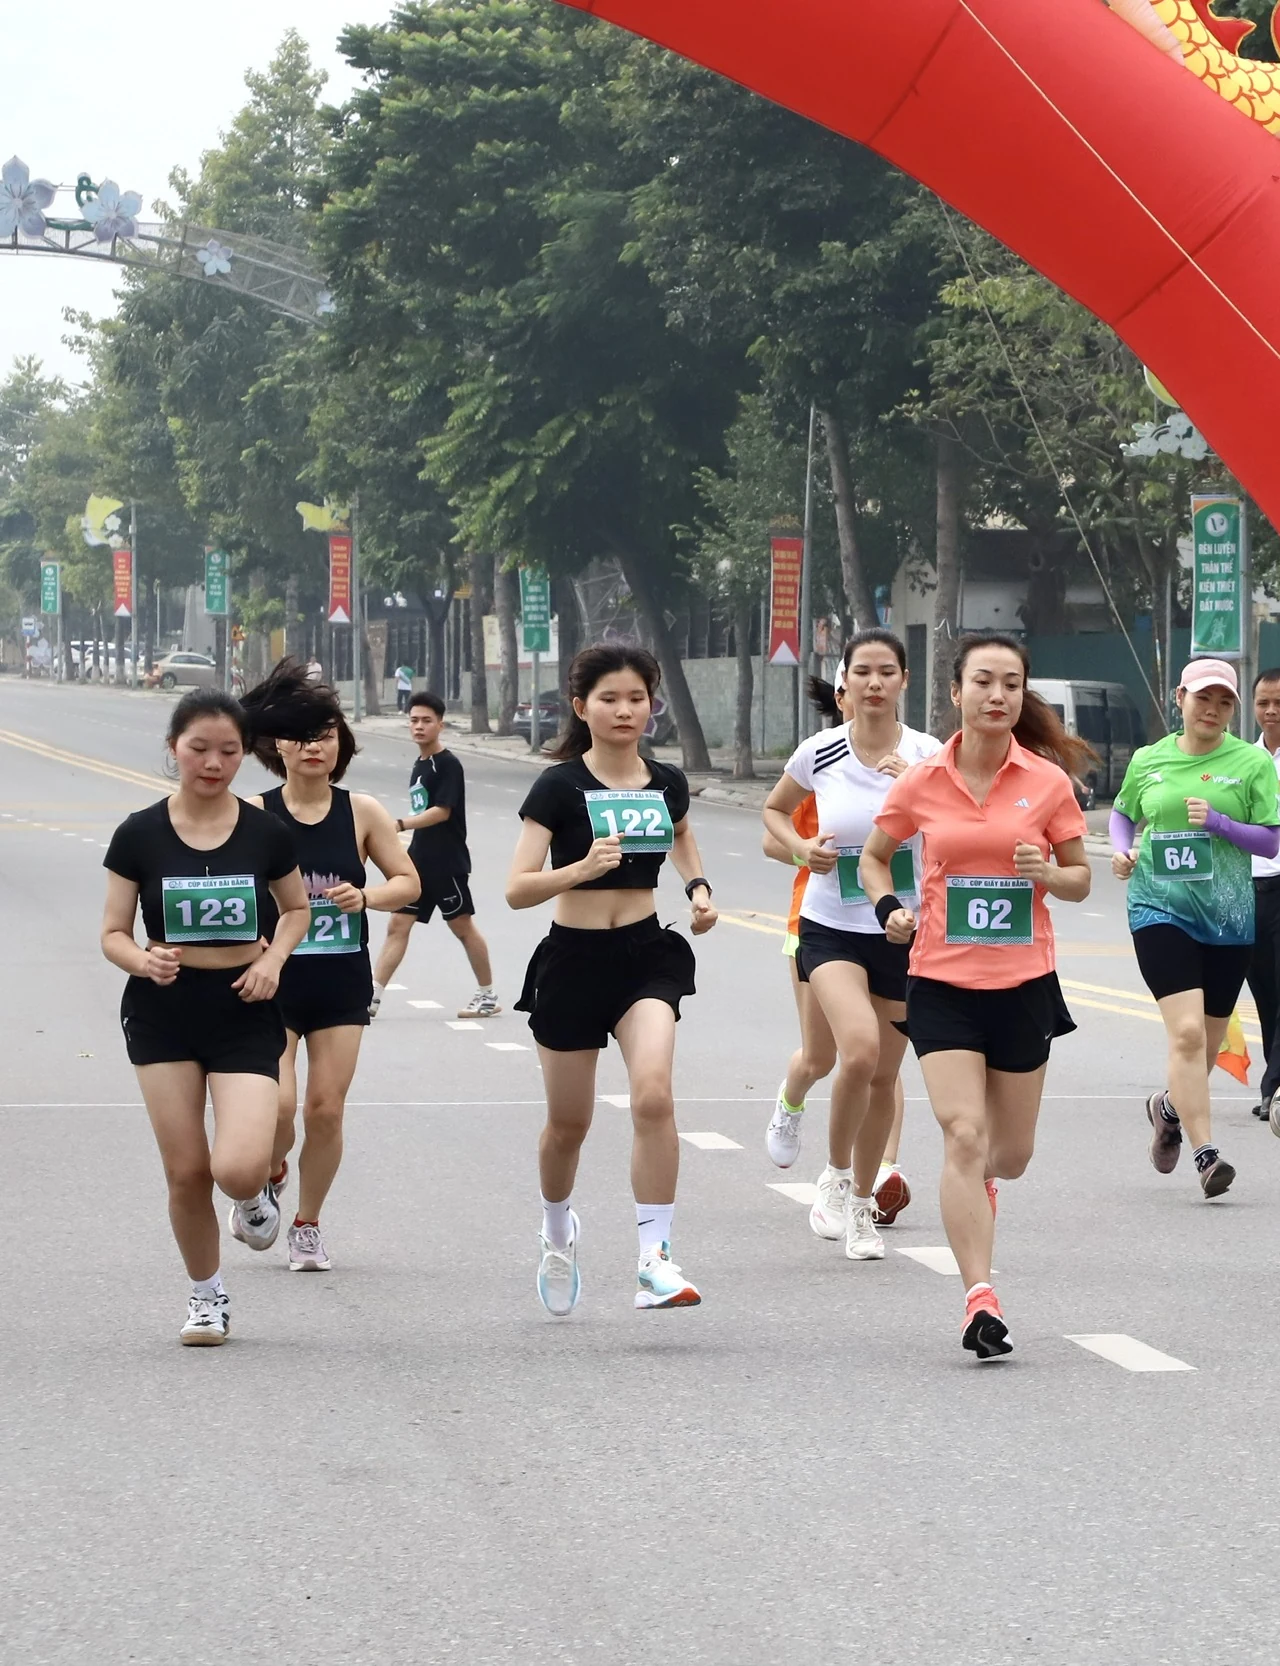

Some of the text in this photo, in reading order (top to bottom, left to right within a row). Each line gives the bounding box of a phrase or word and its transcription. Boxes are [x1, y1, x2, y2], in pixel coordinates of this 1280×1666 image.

[1214, 540, 1236, 557] LUYỆN
[1201, 560, 1219, 573] THÂN
[1217, 578, 1235, 593] THIẾT
[600, 809, 665, 836] 122
[1164, 846, 1197, 870] 64
[176, 897, 246, 926] 123
[968, 898, 1012, 929] 62
